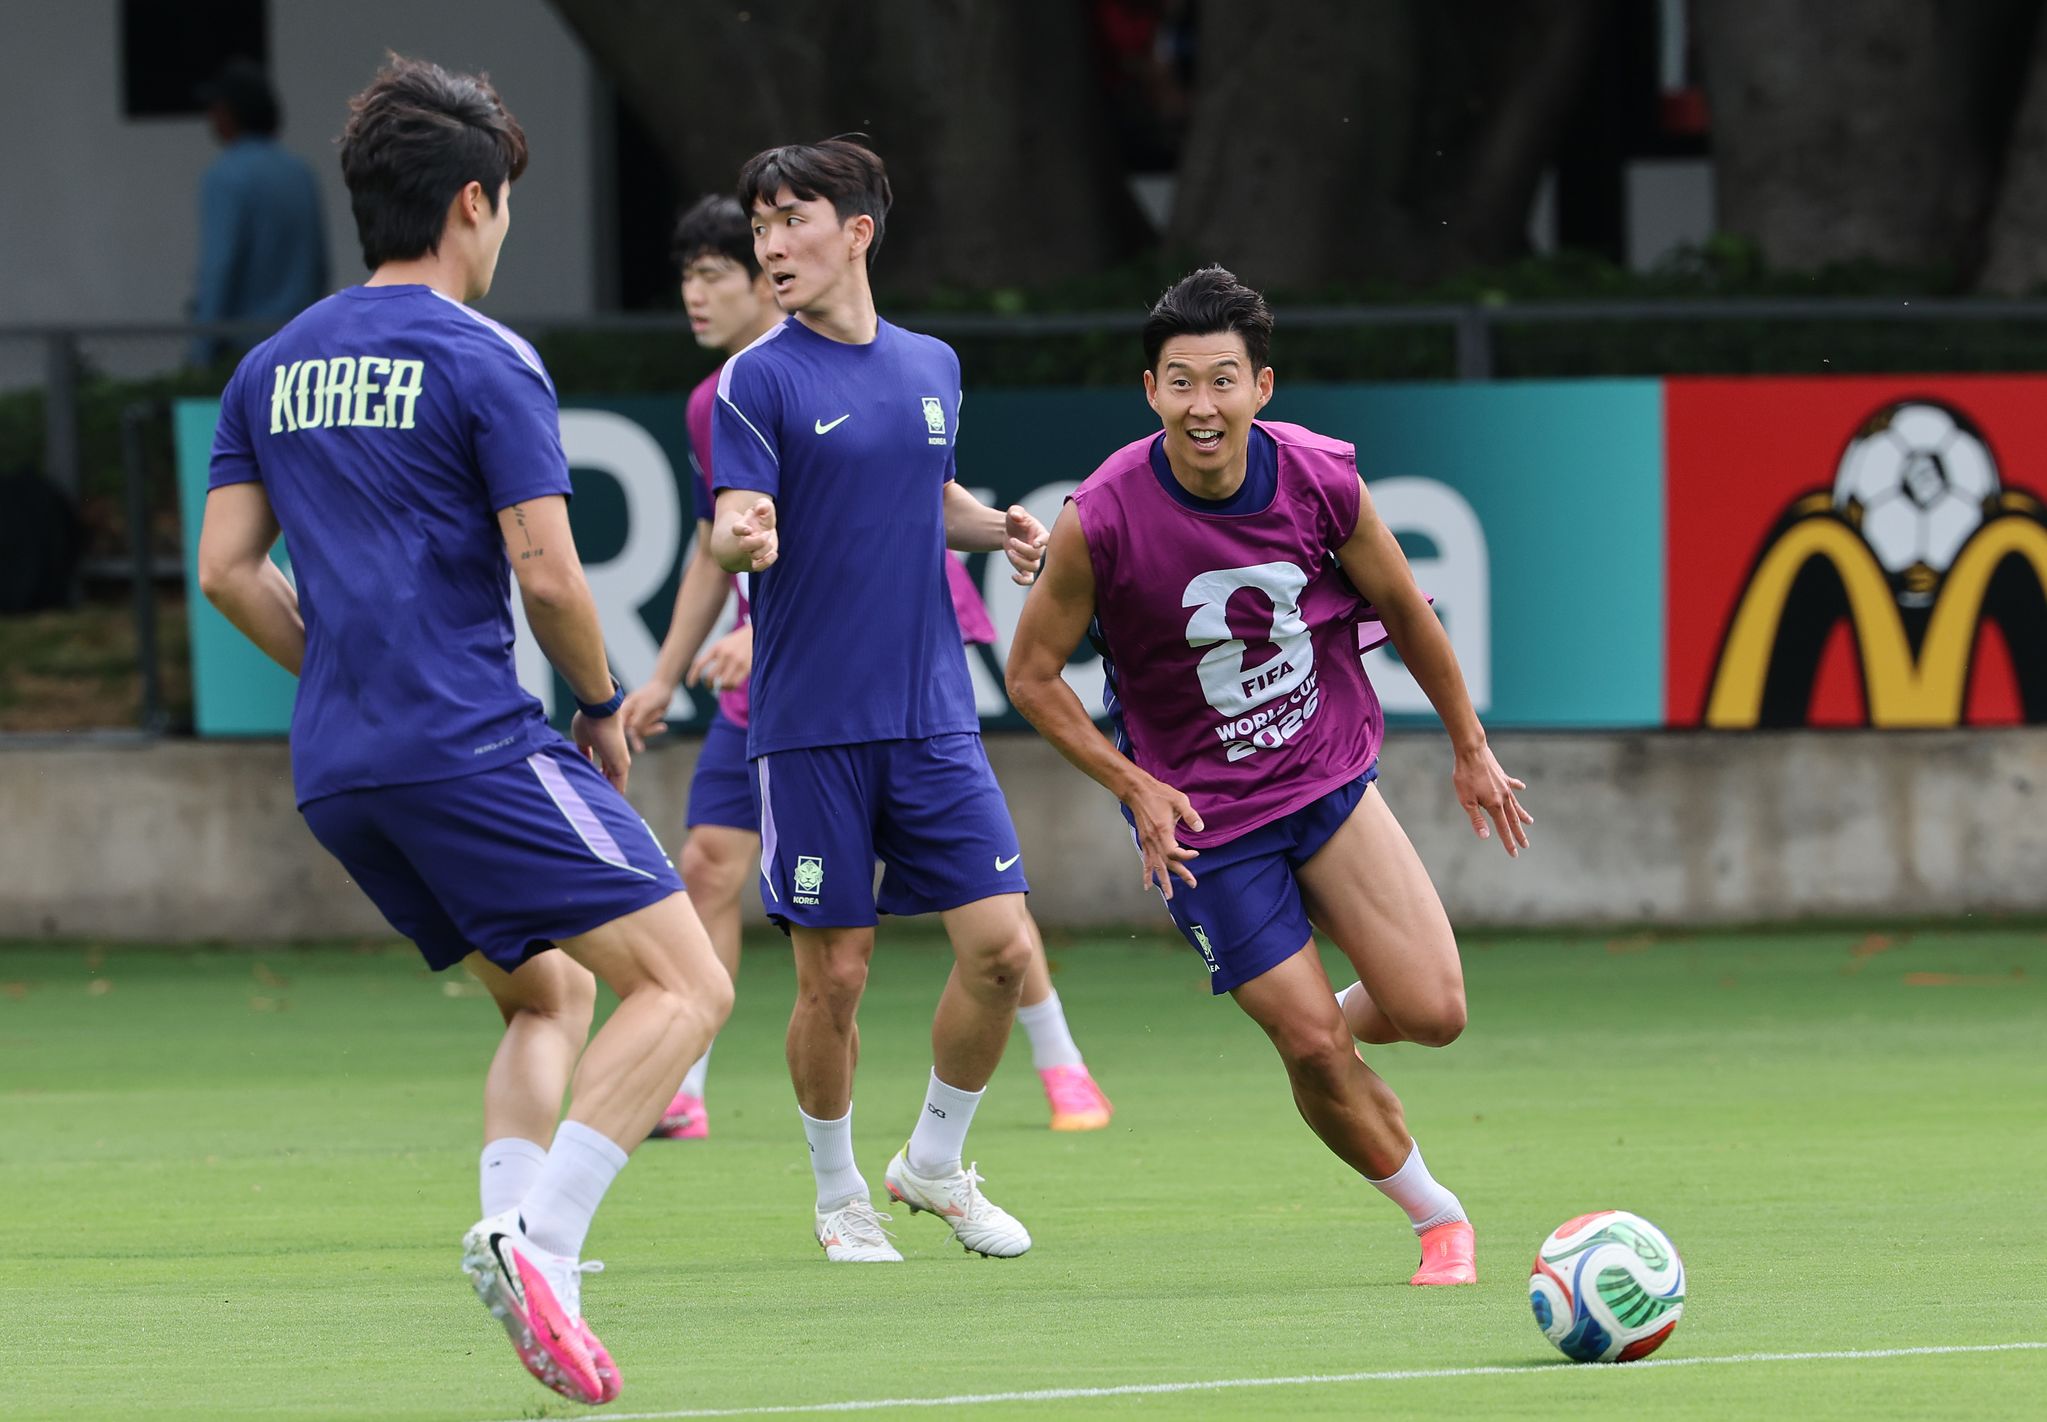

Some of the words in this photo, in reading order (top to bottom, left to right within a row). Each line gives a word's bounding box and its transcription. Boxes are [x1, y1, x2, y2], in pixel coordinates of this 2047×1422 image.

[270, 356, 425, 435] KOREA
[1241, 661, 1295, 699] FIFA
[1222, 687, 1319, 763] 2026
[793, 896, 820, 905] KOREA
